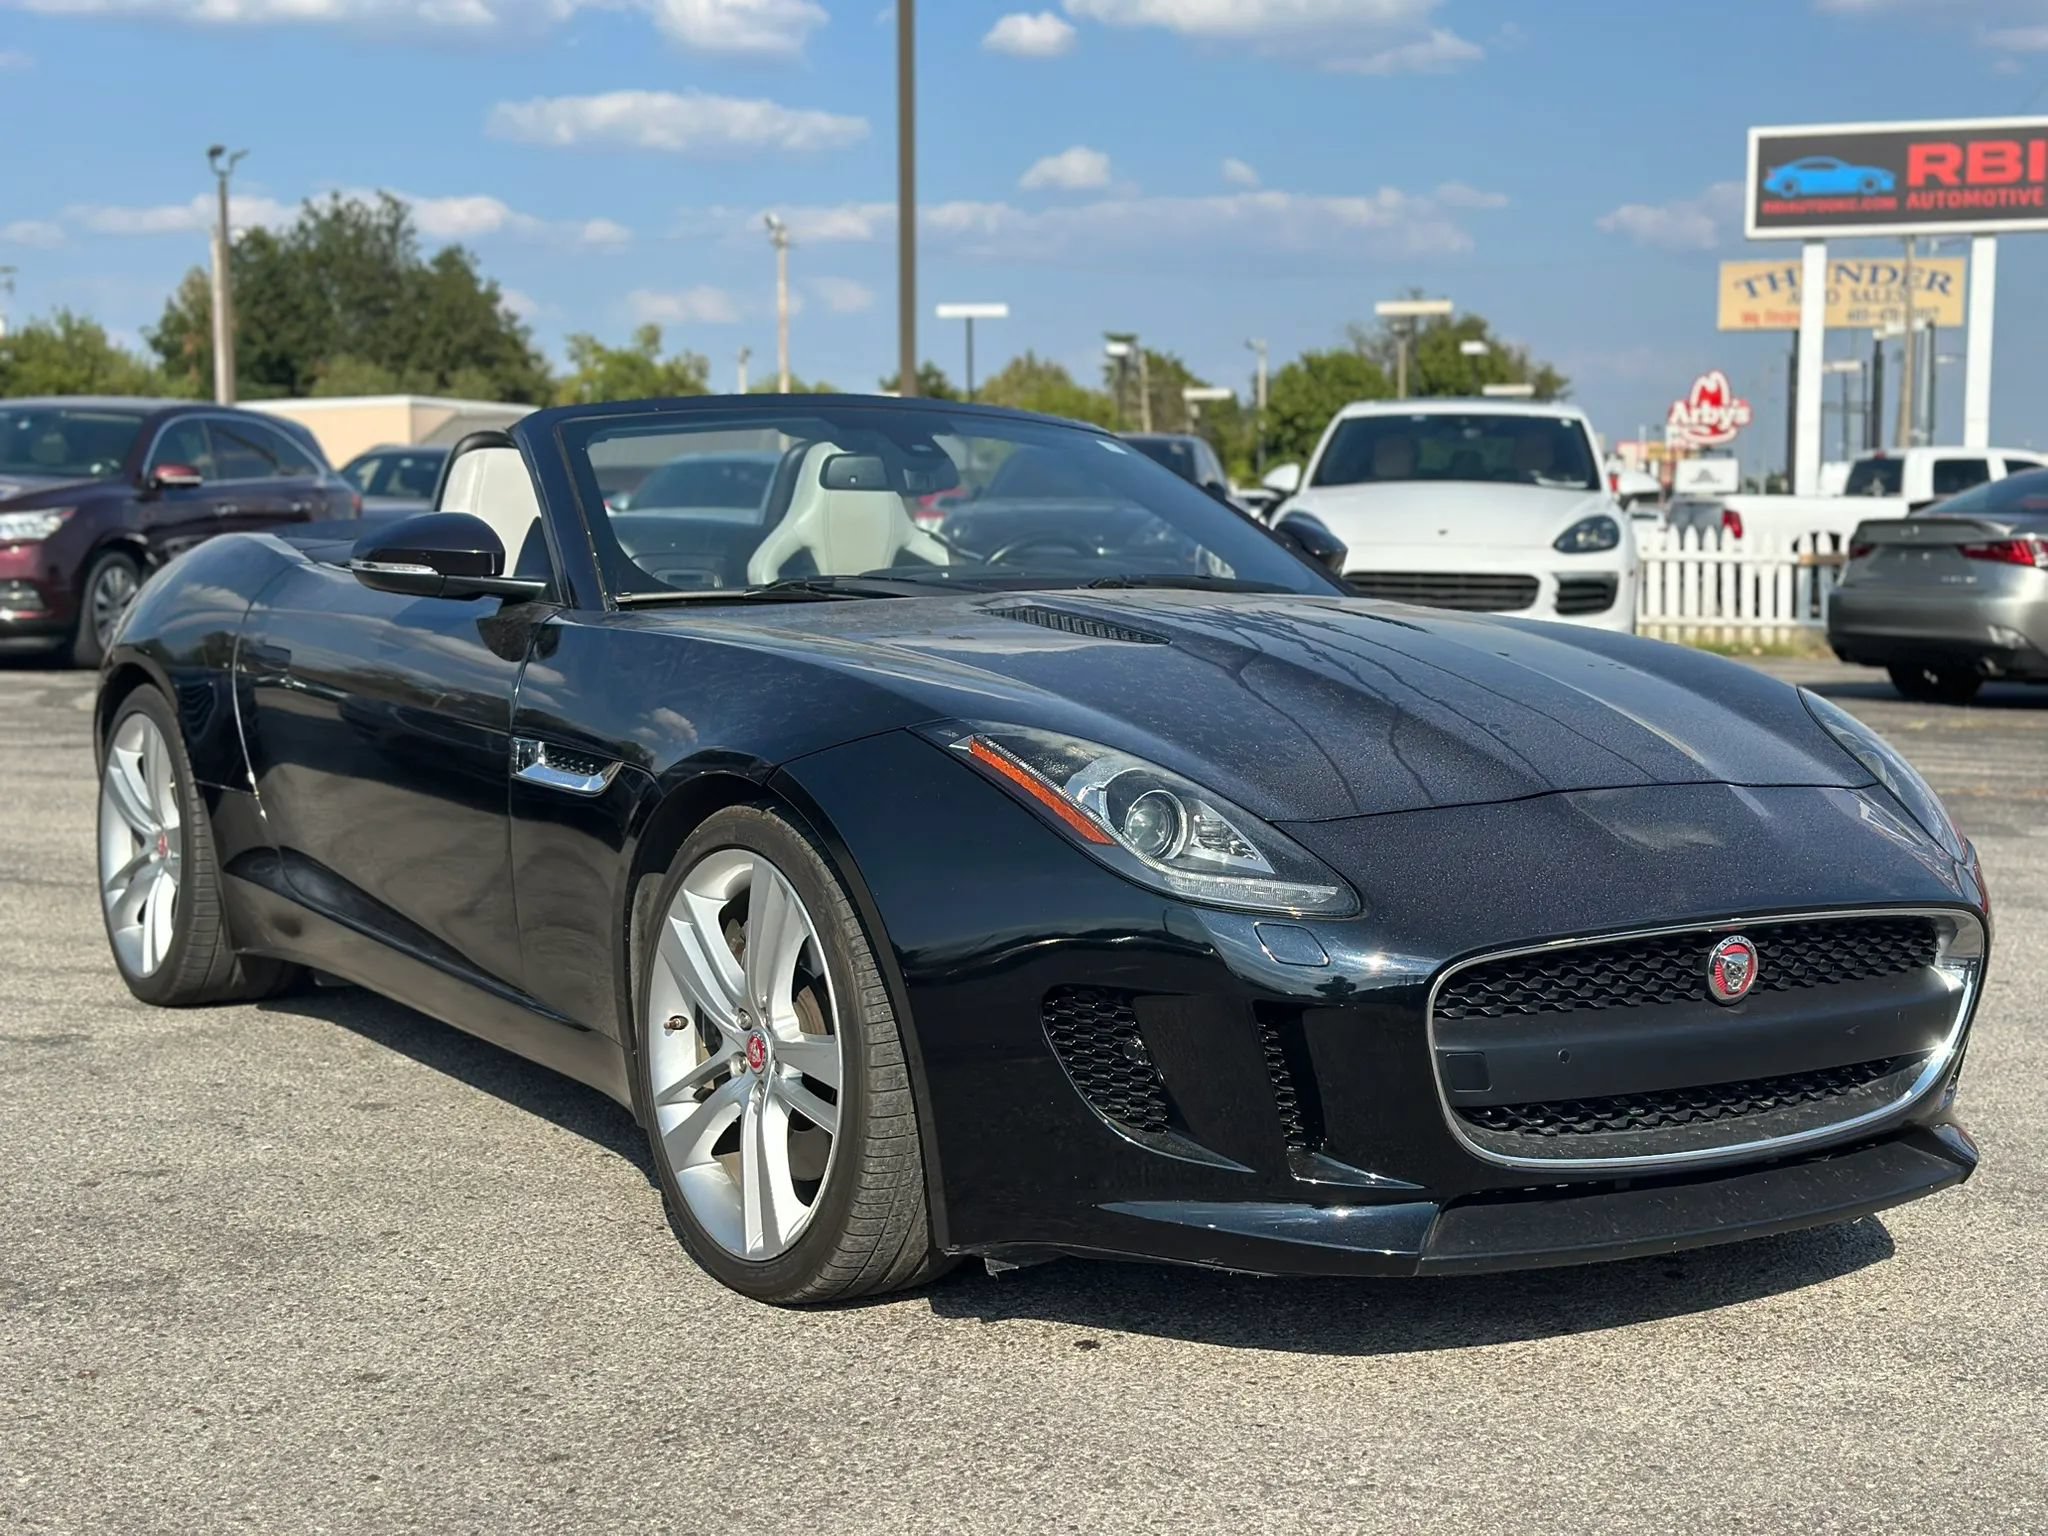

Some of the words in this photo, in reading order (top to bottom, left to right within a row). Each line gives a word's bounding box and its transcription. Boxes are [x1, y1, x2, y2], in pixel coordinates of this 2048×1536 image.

[1907, 139, 2047, 187] RBI
[1906, 187, 2044, 209] AUTOMOTIVE
[1734, 263, 1952, 298] THNDER
[1786, 289, 1841, 306] AO
[1669, 399, 1750, 431] Arby's
